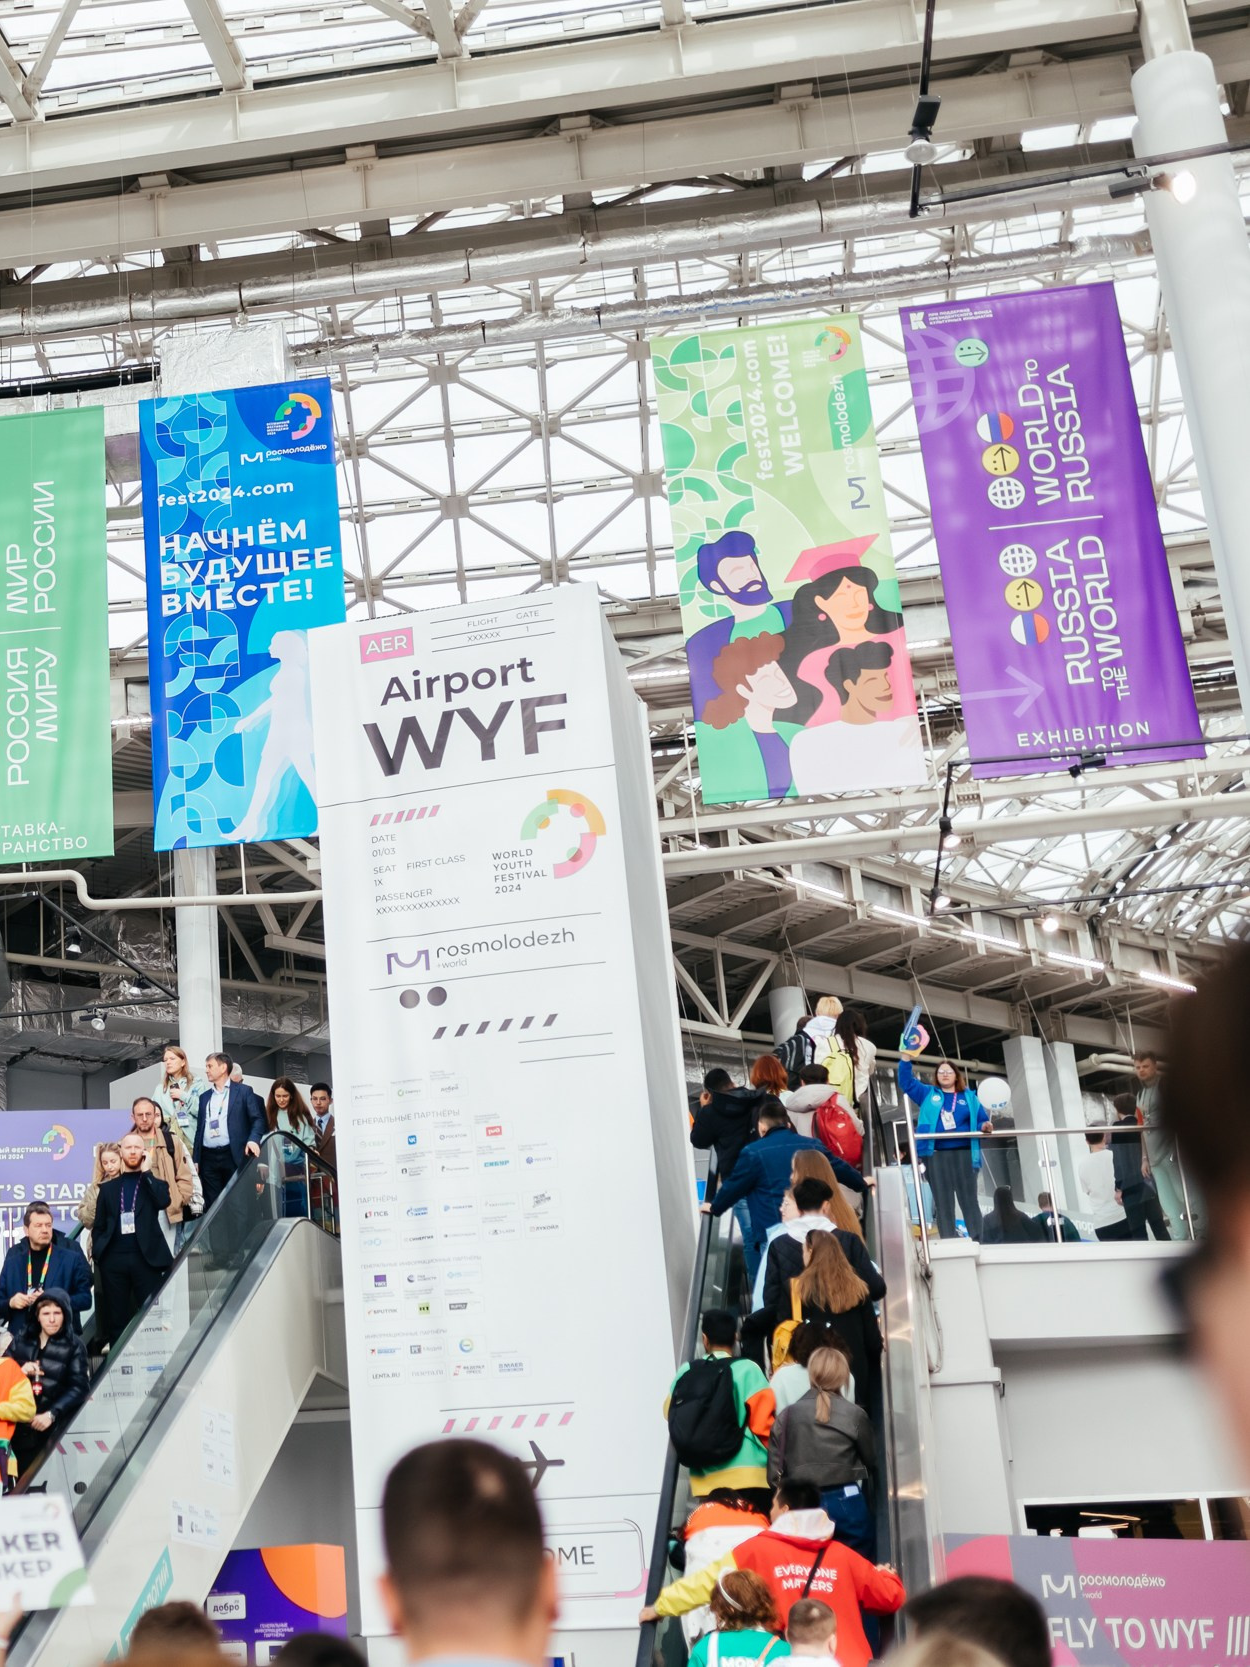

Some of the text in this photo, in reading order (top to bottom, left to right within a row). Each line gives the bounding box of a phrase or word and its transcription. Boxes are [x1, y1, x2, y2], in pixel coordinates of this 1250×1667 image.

[743, 338, 774, 481] fest2024.com
[767, 333, 805, 477] WELCOME!
[829, 374, 856, 473] rosmolodezh
[1018, 358, 1062, 506] WORLD TO
[1047, 363, 1094, 503] RUSSIA
[157, 481, 294, 508] fest2024.com
[33, 480, 57, 613] РОССИИ
[160, 518, 307, 556] НАЧНЁМ
[6, 544, 28, 614] МИР
[161, 546, 334, 585] БУДУЩЕЕ
[162, 578, 314, 618] ВМЕСТЕ!
[1046, 538, 1095, 685] RUSSIA
[467, 610, 540, 628] FLIGHT GATE
[1077, 534, 1131, 701] TO THE WORLD
[365, 635, 408, 656] AER
[34, 647, 58, 743] МИРУ
[380, 657, 536, 706] Airport
[7, 647, 30, 786] РОССИЯ
[362, 692, 568, 777] WYF
[1017, 721, 1151, 747] EXHIBITION
[371, 834, 398, 844] DATE
[492, 848, 533, 861] WORLD
[373, 854, 466, 875] SEAT FIRST CLASS
[493, 860, 532, 871] YOUTH
[494, 869, 548, 883] FESTIVAL
[375, 888, 433, 903] PASSENGER
[494, 883, 522, 894] 2024
[436, 928, 575, 958] rosmolodezh
[352, 1113, 412, 1127] ГЕНЕРАЛЬНЫЕ
[413, 1108, 461, 1121] ПАРТНЁРЫ
[33, 1183, 94, 1200] STAR
[1079, 1573, 1166, 1591] росмолодёжь
[213, 1603, 240, 1613] добро
[1047, 1617, 1214, 1649] FLY TO WYF
